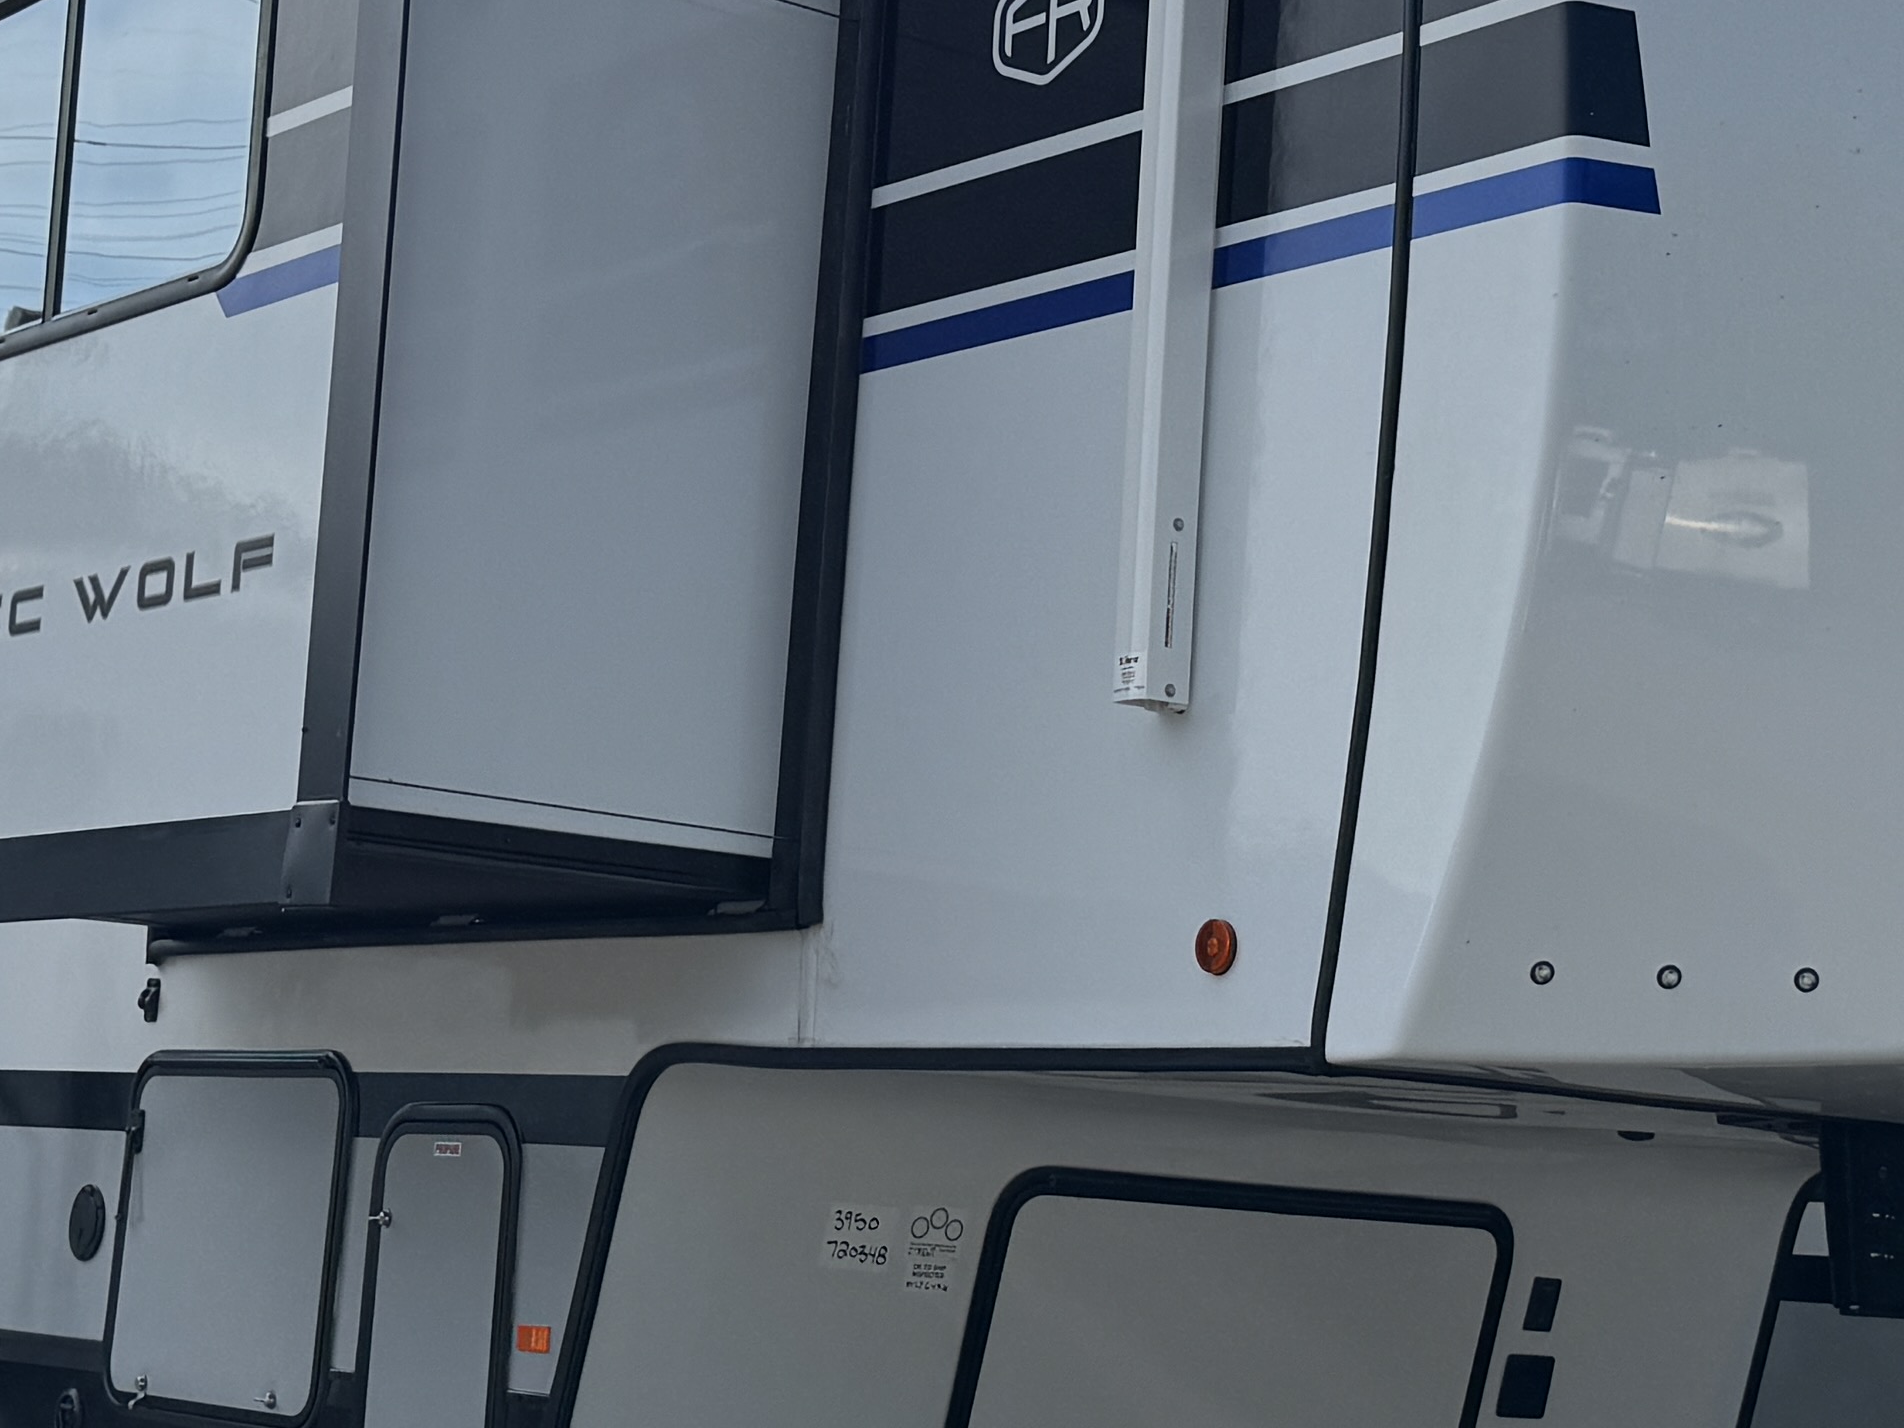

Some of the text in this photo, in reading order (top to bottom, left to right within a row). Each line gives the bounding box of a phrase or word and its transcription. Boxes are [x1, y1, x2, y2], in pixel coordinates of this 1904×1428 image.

[72, 532, 276, 625] WOLF
[834, 1209, 880, 1231] 3950
[827, 1240, 888, 1265] 720348
